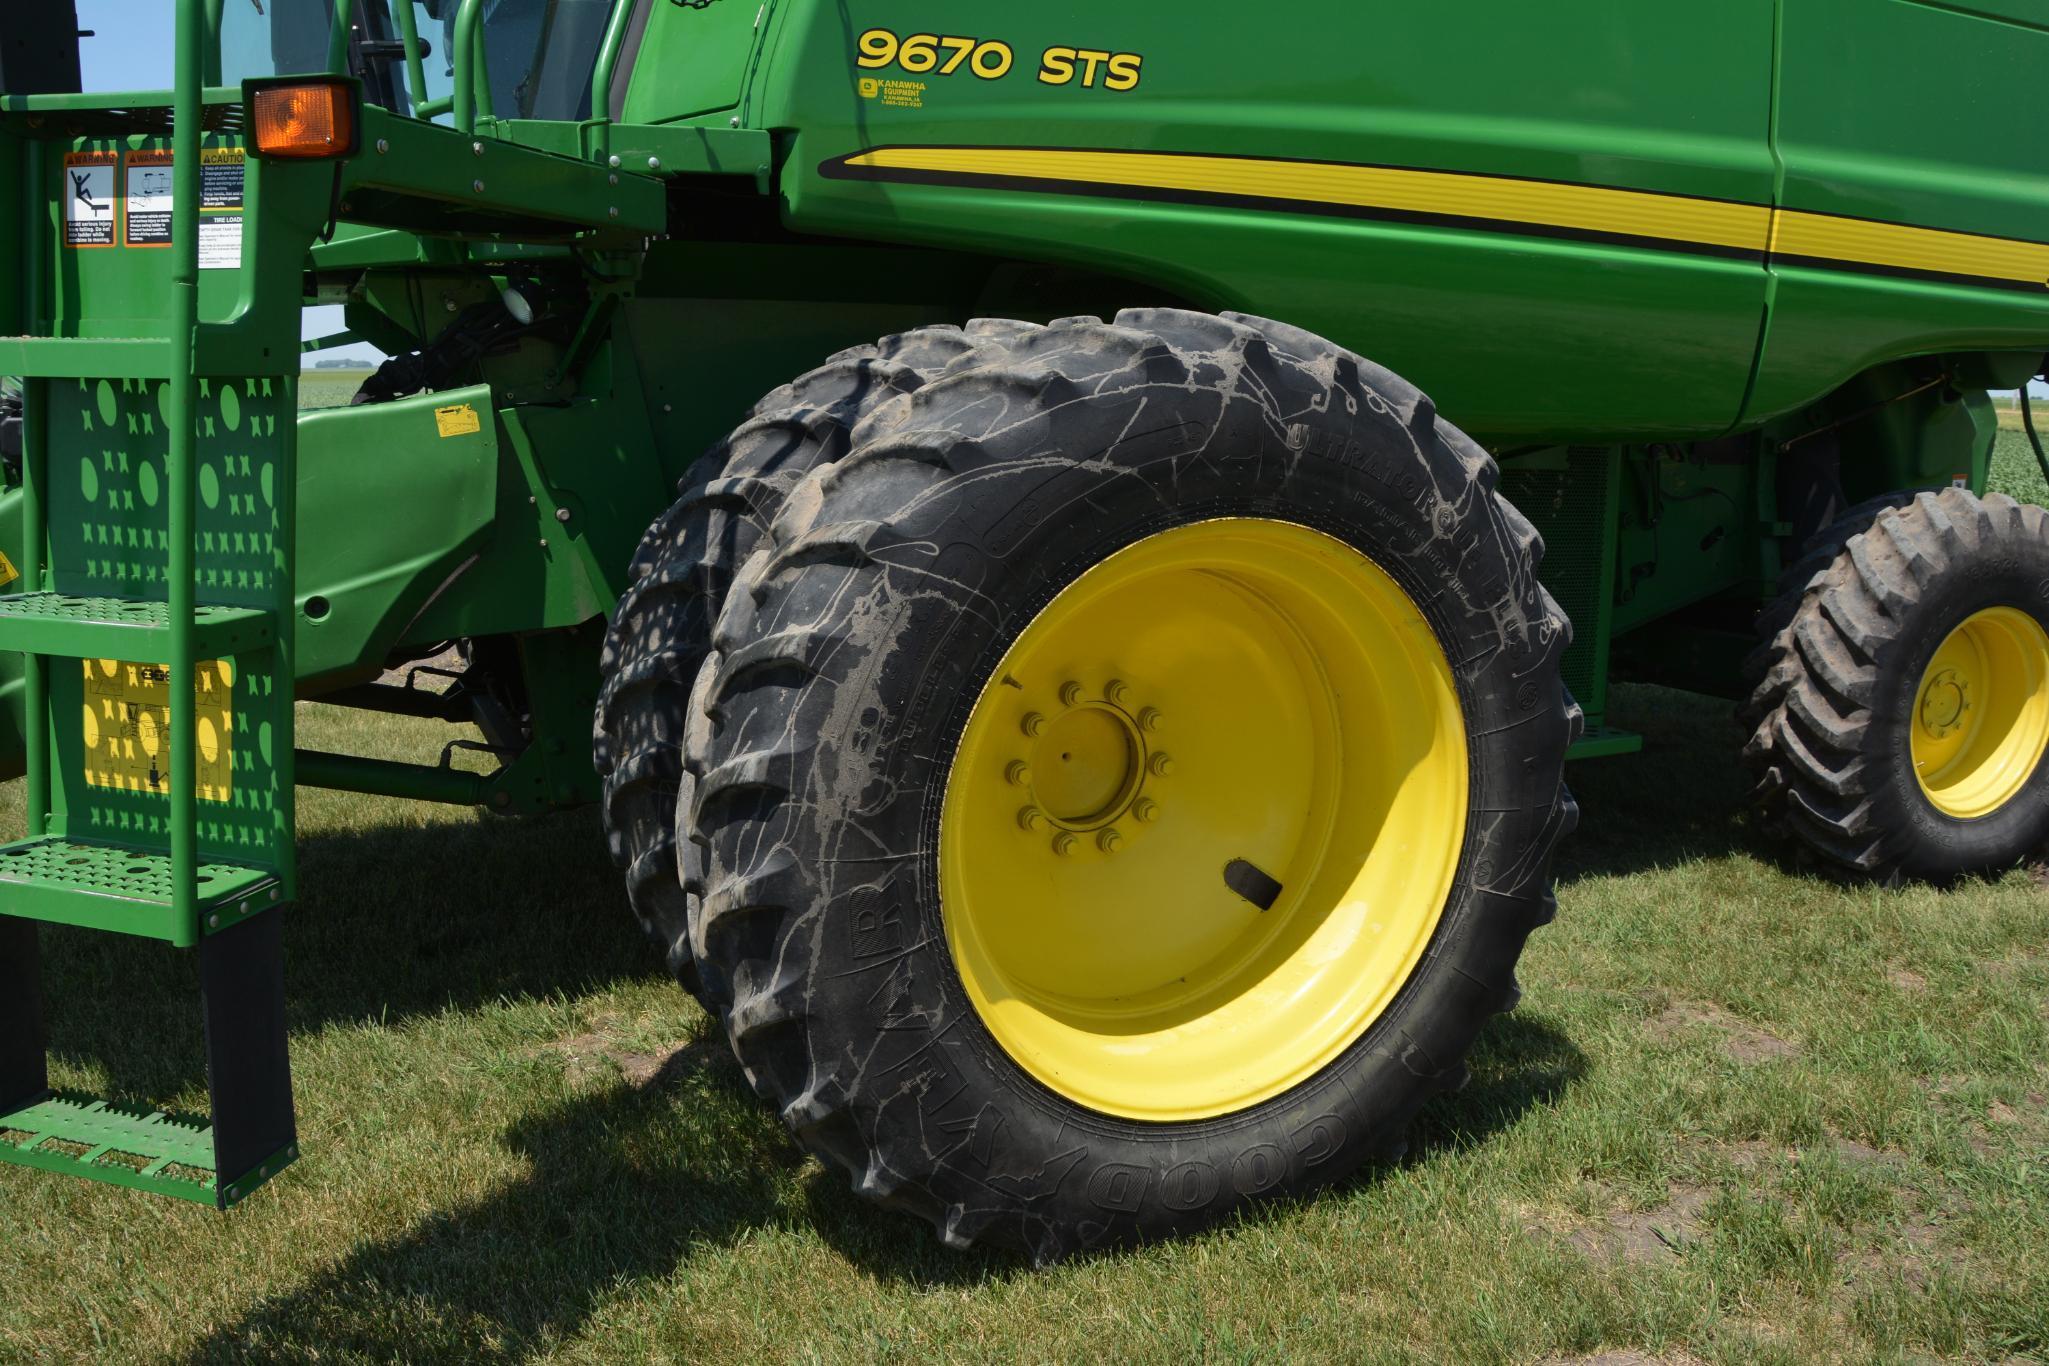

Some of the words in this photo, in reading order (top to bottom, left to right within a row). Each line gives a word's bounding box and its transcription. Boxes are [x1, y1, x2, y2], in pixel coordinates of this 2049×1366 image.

[856, 27, 1013, 80] 9670
[1037, 45, 1143, 91] STS
[877, 79, 926, 90] KANAWHA
[884, 88, 920, 97] EQUIPMENT
[75, 155, 114, 164] WARNING
